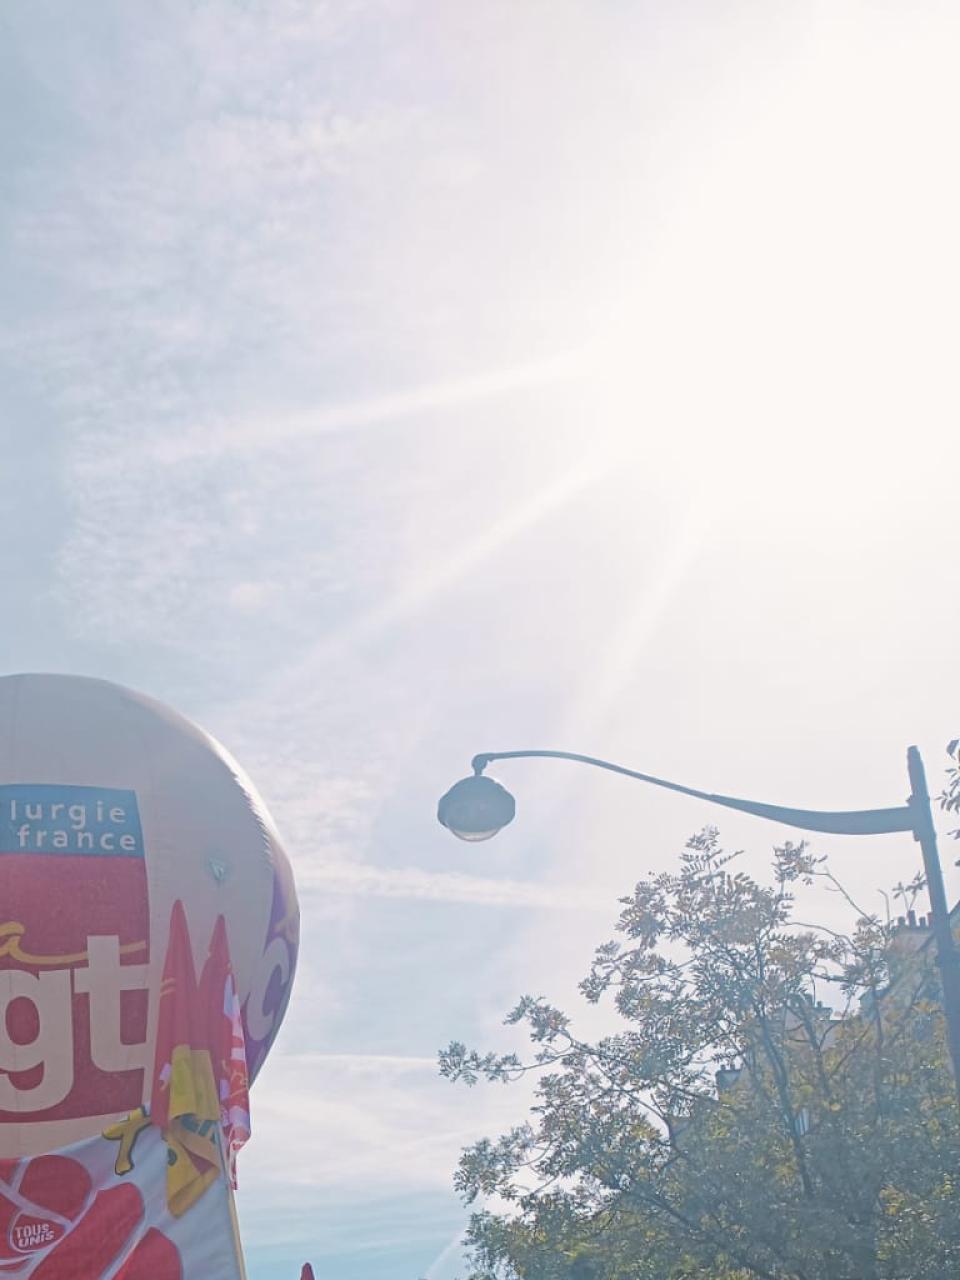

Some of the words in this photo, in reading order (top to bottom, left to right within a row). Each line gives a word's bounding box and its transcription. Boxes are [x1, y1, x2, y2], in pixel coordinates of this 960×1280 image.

[16, 822, 137, 852] france
[15, 1223, 50, 1240] TOUS
[18, 1230, 55, 1248] UNIS
